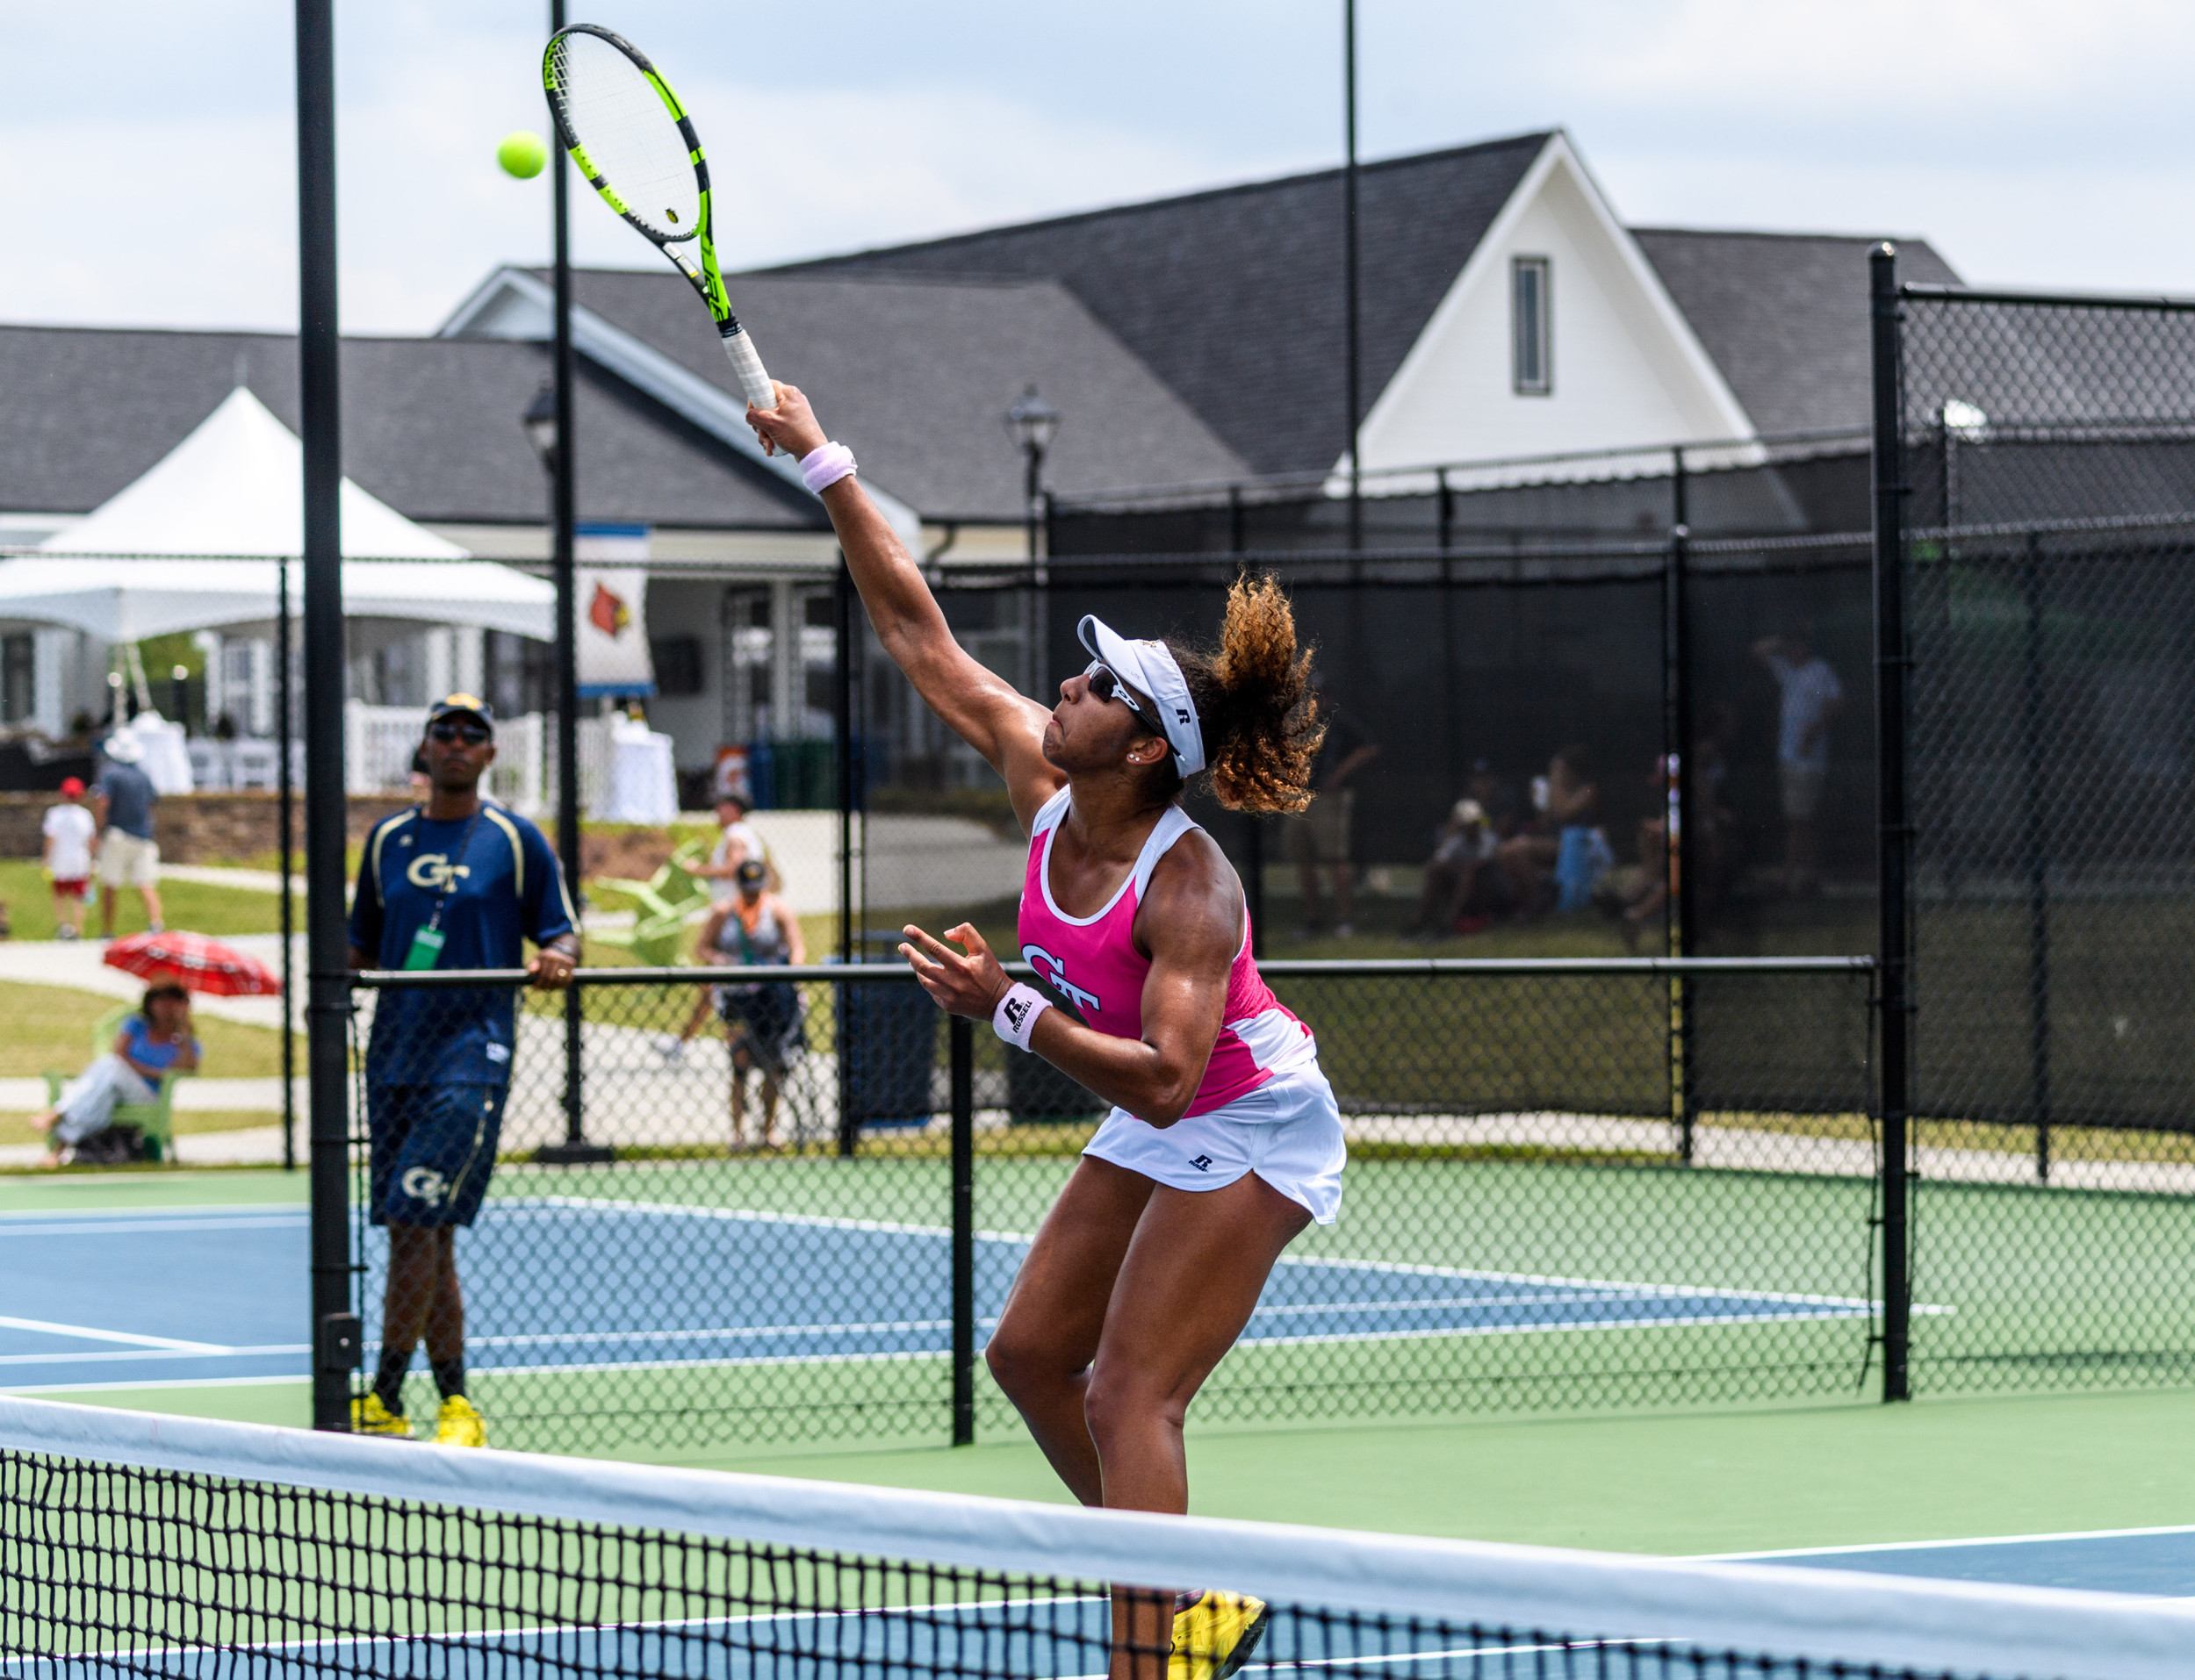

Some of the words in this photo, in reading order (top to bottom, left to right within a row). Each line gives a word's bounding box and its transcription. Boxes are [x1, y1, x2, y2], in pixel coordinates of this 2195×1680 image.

[1176, 708, 1191, 725] R
[407, 853, 471, 894] GT
[1004, 997, 1023, 1025] R
[1012, 1001, 1033, 1034] RUSSELL
